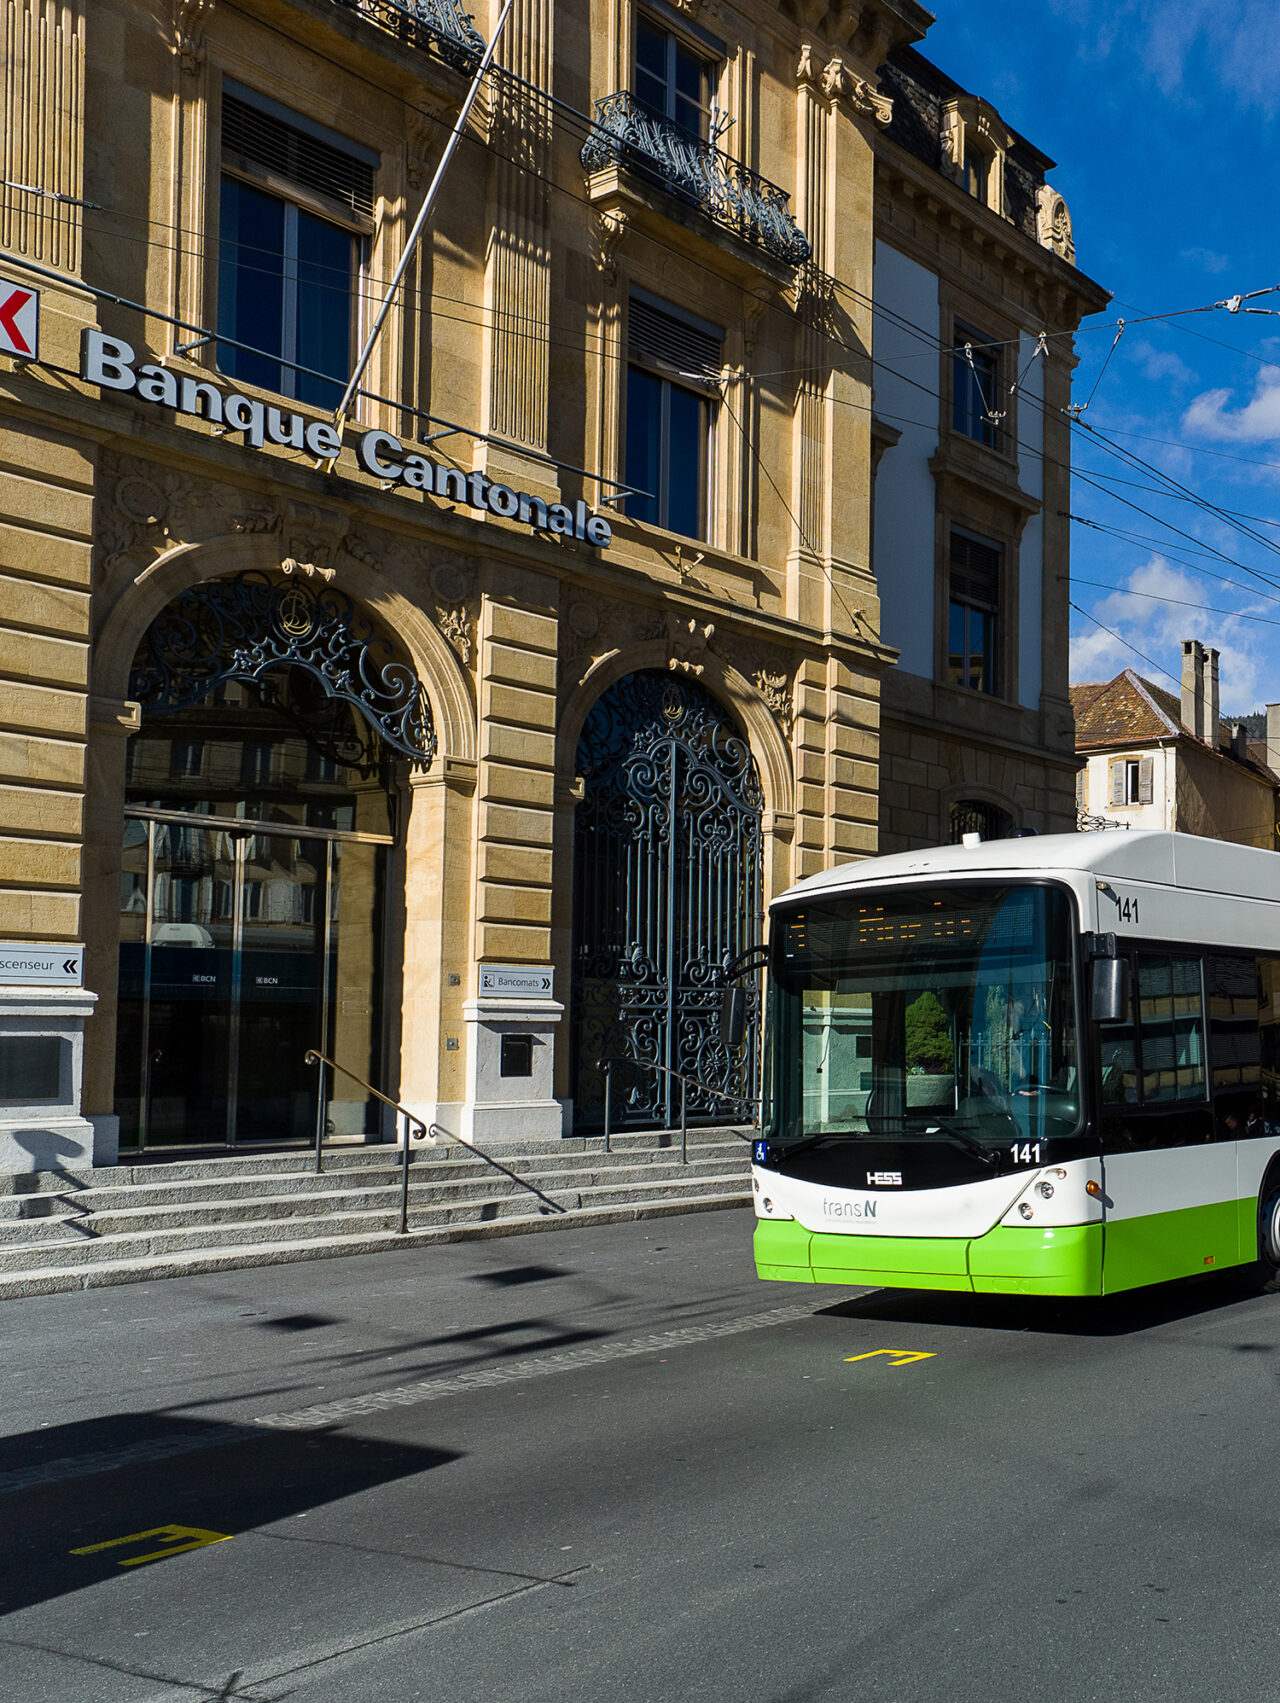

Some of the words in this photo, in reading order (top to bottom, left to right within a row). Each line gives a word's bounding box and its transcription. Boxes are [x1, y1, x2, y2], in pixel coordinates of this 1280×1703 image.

[80, 327, 341, 459] Banque
[356, 429, 612, 547] Cantonale
[1115, 896, 1139, 924] 141
[498, 977, 540, 987] Bancomats
[1010, 1143, 1041, 1164] 141
[866, 1171, 902, 1186] HESS
[823, 1197, 877, 1218] transN
